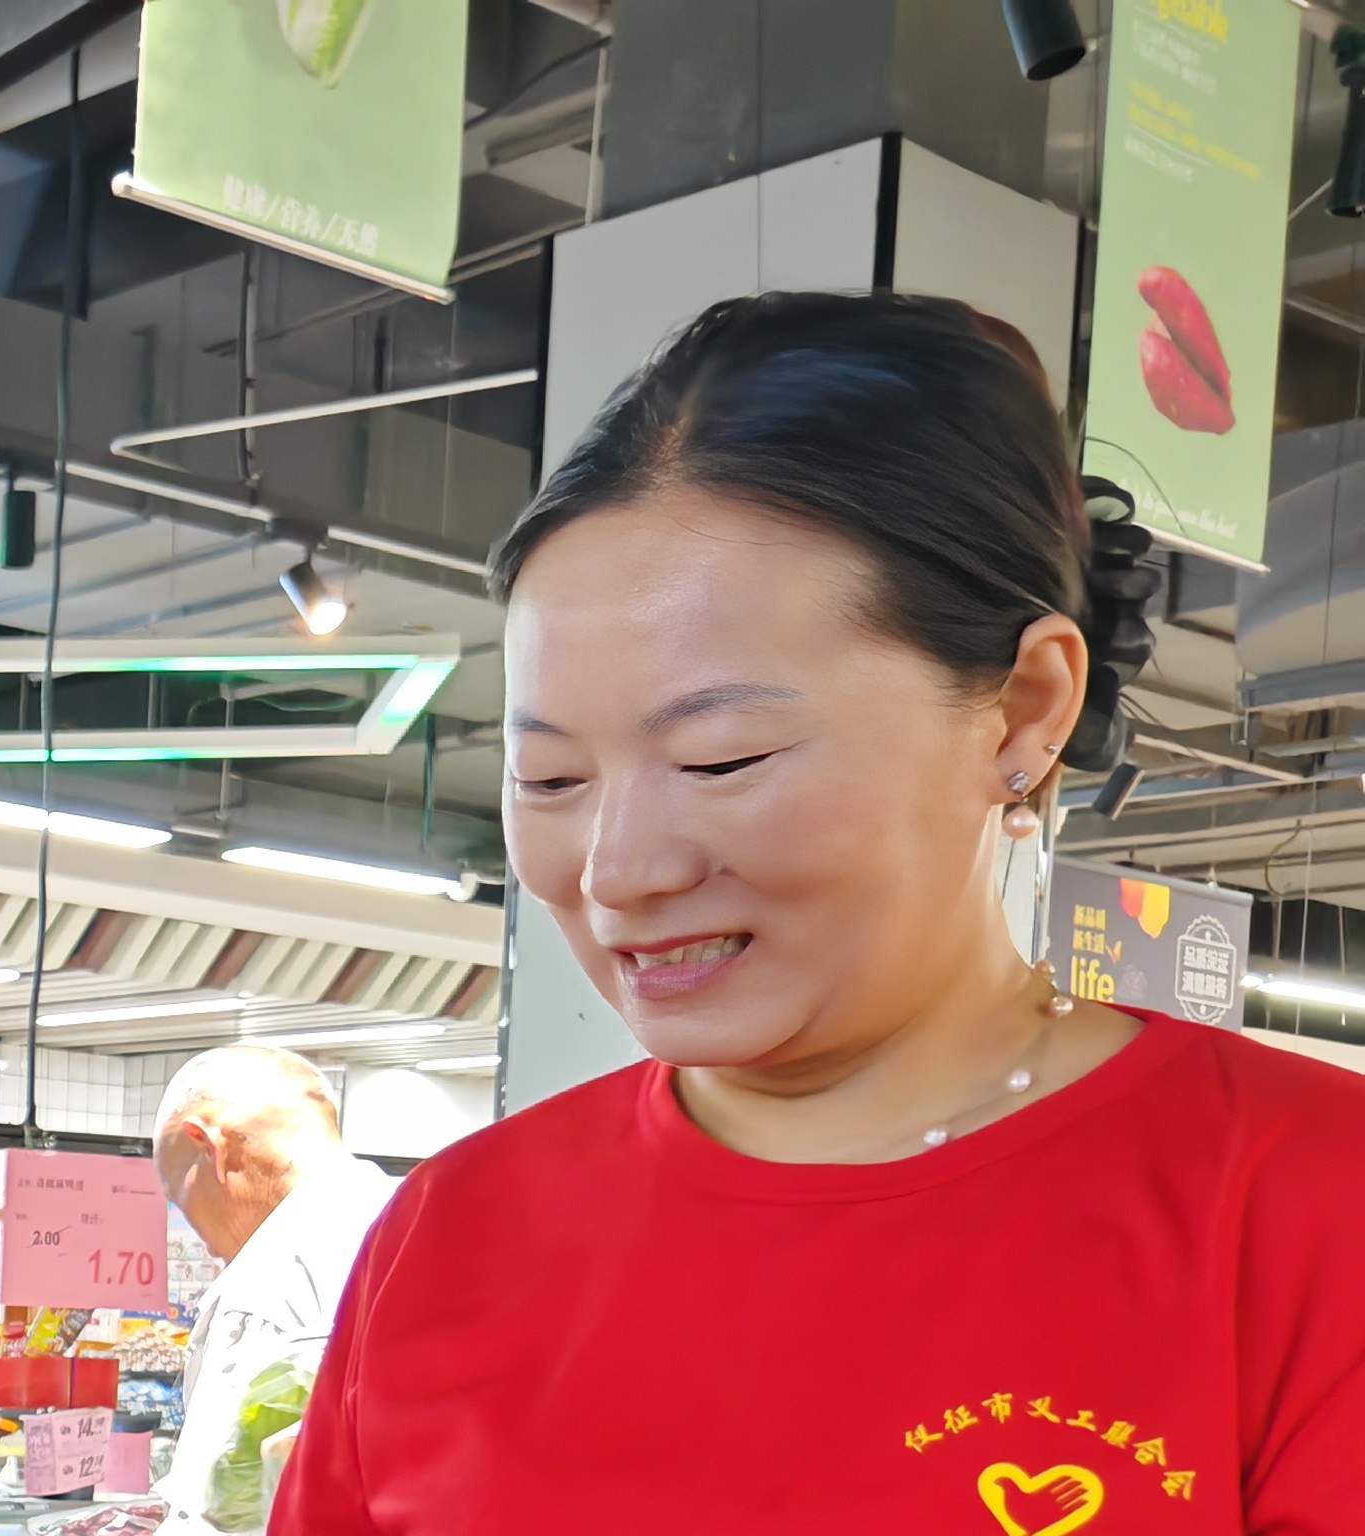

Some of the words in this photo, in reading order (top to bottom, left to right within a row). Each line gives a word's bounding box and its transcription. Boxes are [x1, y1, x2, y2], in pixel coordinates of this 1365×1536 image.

[1070, 954, 1116, 1003] life
[32, 1230, 61, 1246] 2.00
[88, 1248, 155, 1286] 1.70
[904, 1392, 1197, 1501] 仪征市义工联合会
